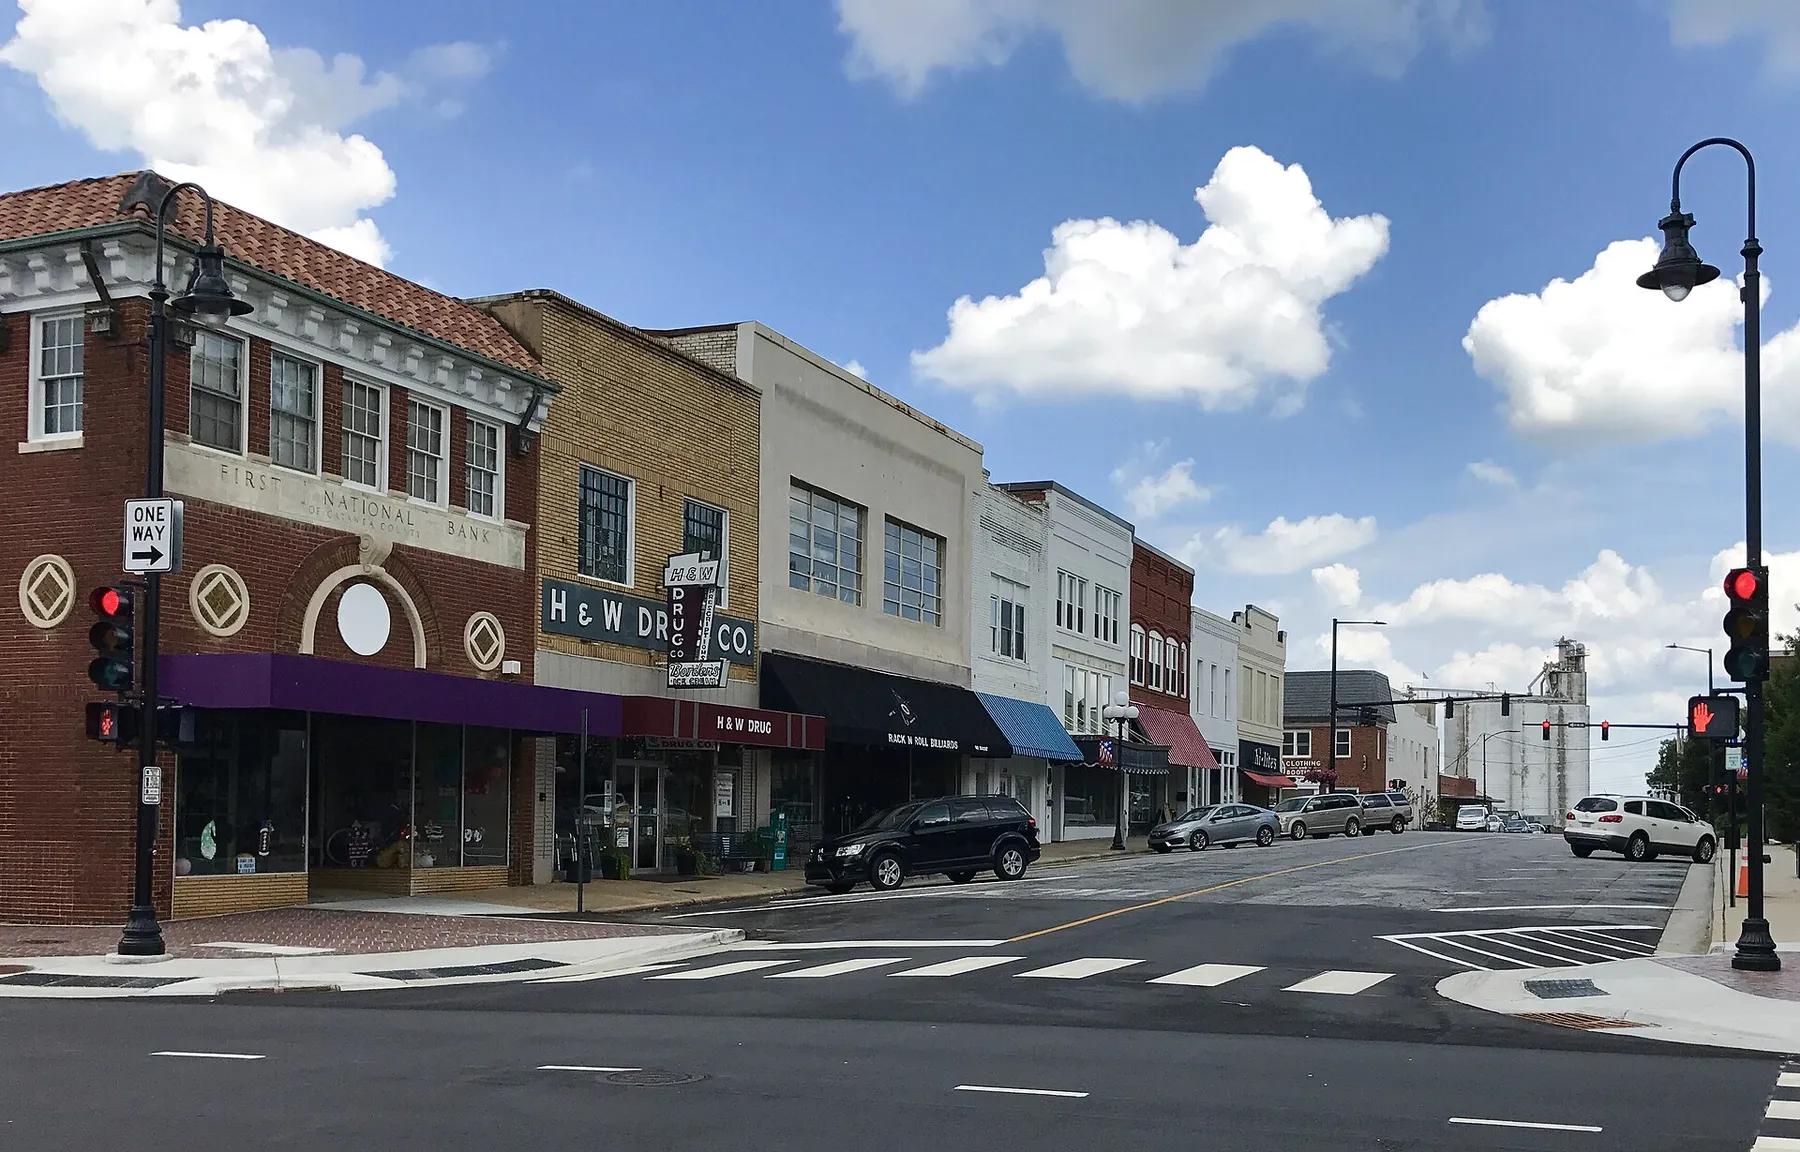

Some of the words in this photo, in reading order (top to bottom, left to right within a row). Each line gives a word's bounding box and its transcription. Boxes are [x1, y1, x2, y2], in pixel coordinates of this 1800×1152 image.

[221, 464, 281, 494] FIRST
[324, 490, 414, 526] NATIONAL
[448, 520, 490, 543] BANK
[134, 506, 165, 522] ONE
[133, 525, 165, 541] WAY
[550, 588, 566, 622] H
[578, 602, 593, 626] &
[602, 598, 623, 632] W
[638, 606, 668, 641] DR
[717, 623, 752, 656] CO.
[671, 588, 685, 646] DRUG
[670, 649, 684, 658] CO
[748, 719, 772, 734] DRUG
[888, 733, 906, 744] RACK
[914, 736, 929, 747] ROLL
[930, 738, 959, 750] BILLIARDS
